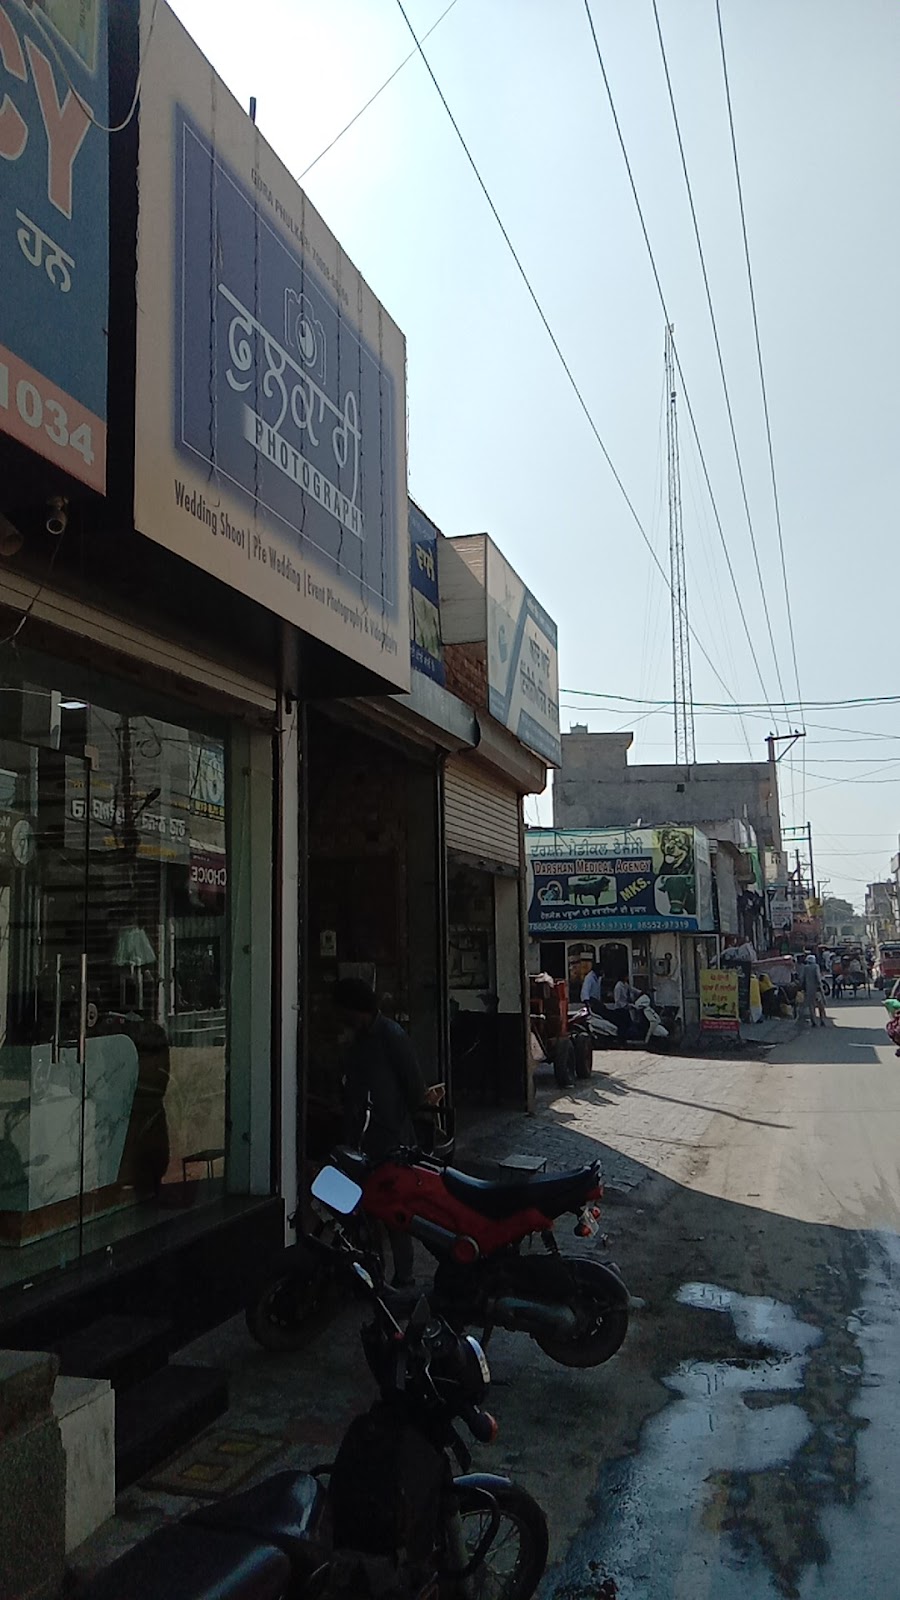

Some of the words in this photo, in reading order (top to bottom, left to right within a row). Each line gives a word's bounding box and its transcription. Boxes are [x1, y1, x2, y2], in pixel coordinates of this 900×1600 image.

[174, 479, 217, 536] Wedding
[220, 512, 245, 549] Shoot
[253, 534, 267, 563] Pre
[269, 546, 300, 592] Wedding
[307, 574, 325, 604] Event
[326, 588, 363, 634] Photography
[534, 861, 575, 875] DARSHAN
[575, 859, 614, 875] MEDICAL
[615, 858, 652, 874] AGENCY
